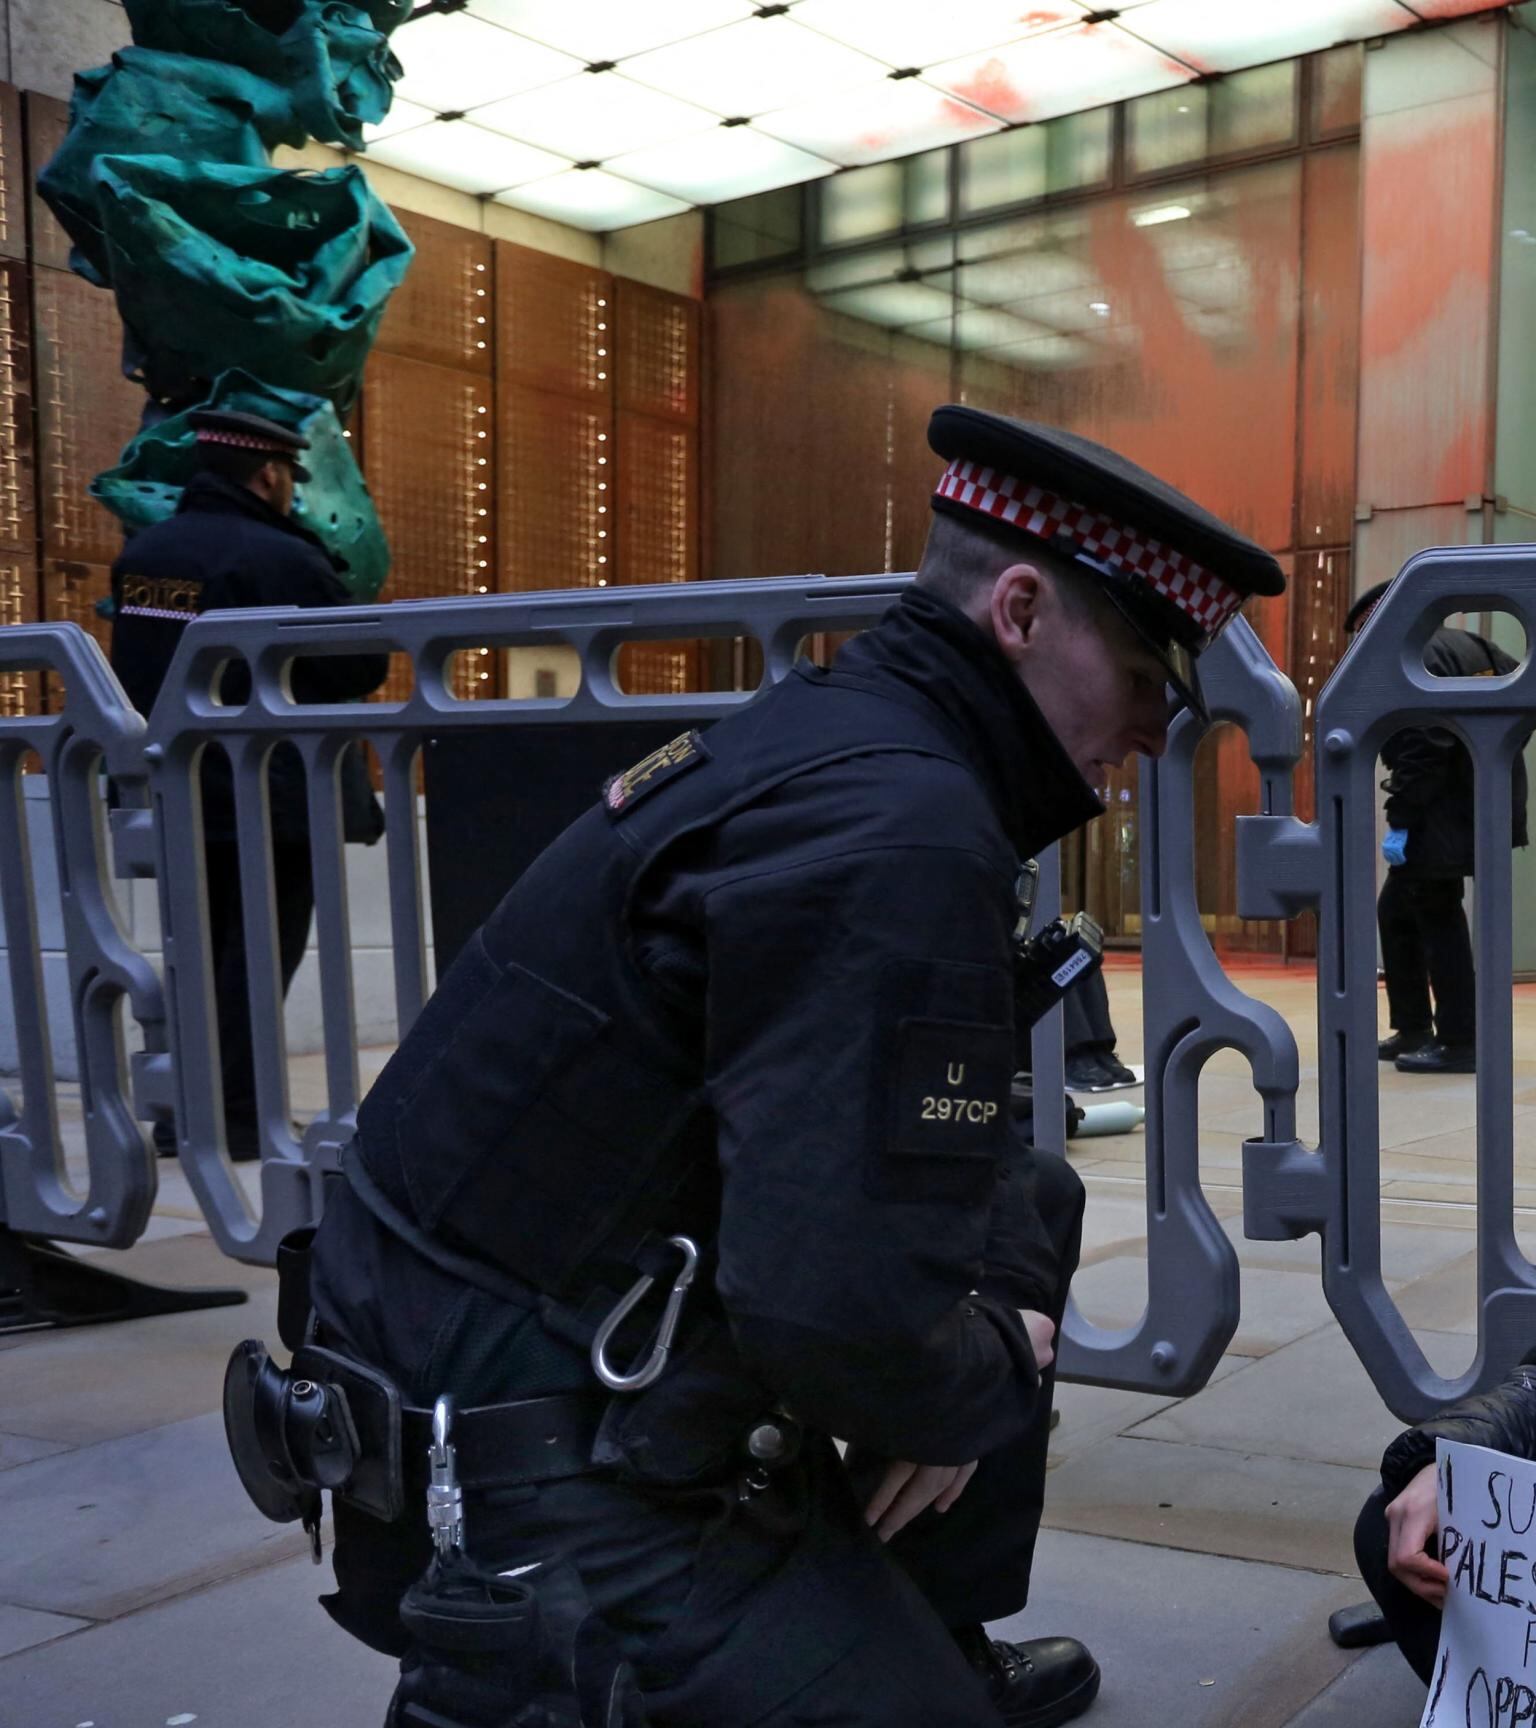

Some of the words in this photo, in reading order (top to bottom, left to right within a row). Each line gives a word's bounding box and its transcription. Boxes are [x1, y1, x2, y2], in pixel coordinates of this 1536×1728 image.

[121, 583, 200, 611] POLICE
[947, 1062, 965, 1085] U
[921, 1096, 998, 1124] 297CP
[1442, 1453, 1453, 1516] I
